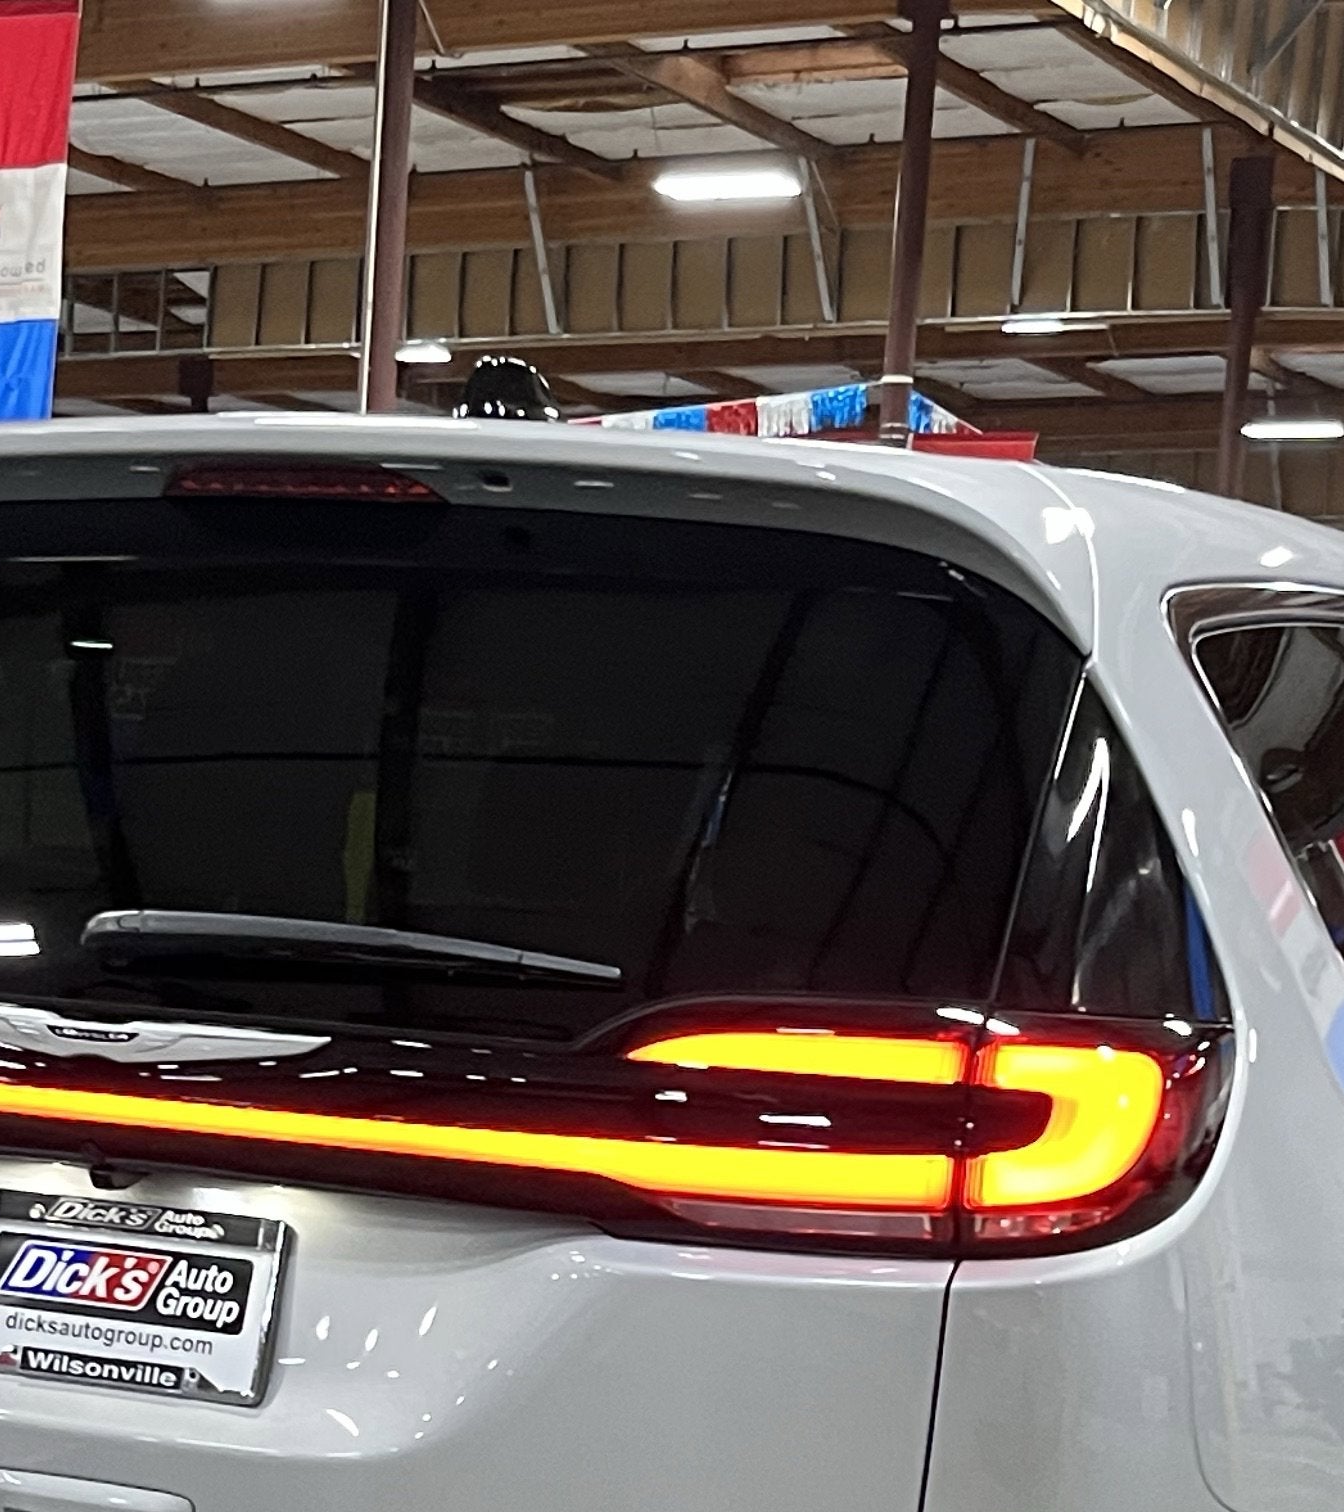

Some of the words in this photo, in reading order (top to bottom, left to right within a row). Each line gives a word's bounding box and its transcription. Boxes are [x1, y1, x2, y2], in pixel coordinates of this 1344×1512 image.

[55, 1201, 149, 1227] Dick's
[161, 1210, 206, 1226] Auto
[154, 1221, 214, 1239] Group
[7, 1248, 150, 1302] Dick's
[164, 1259, 235, 1295] Auto
[156, 1287, 240, 1328] Group
[5, 1311, 214, 1356] dicksautogroup.com
[24, 1350, 178, 1388] Wilsonville
